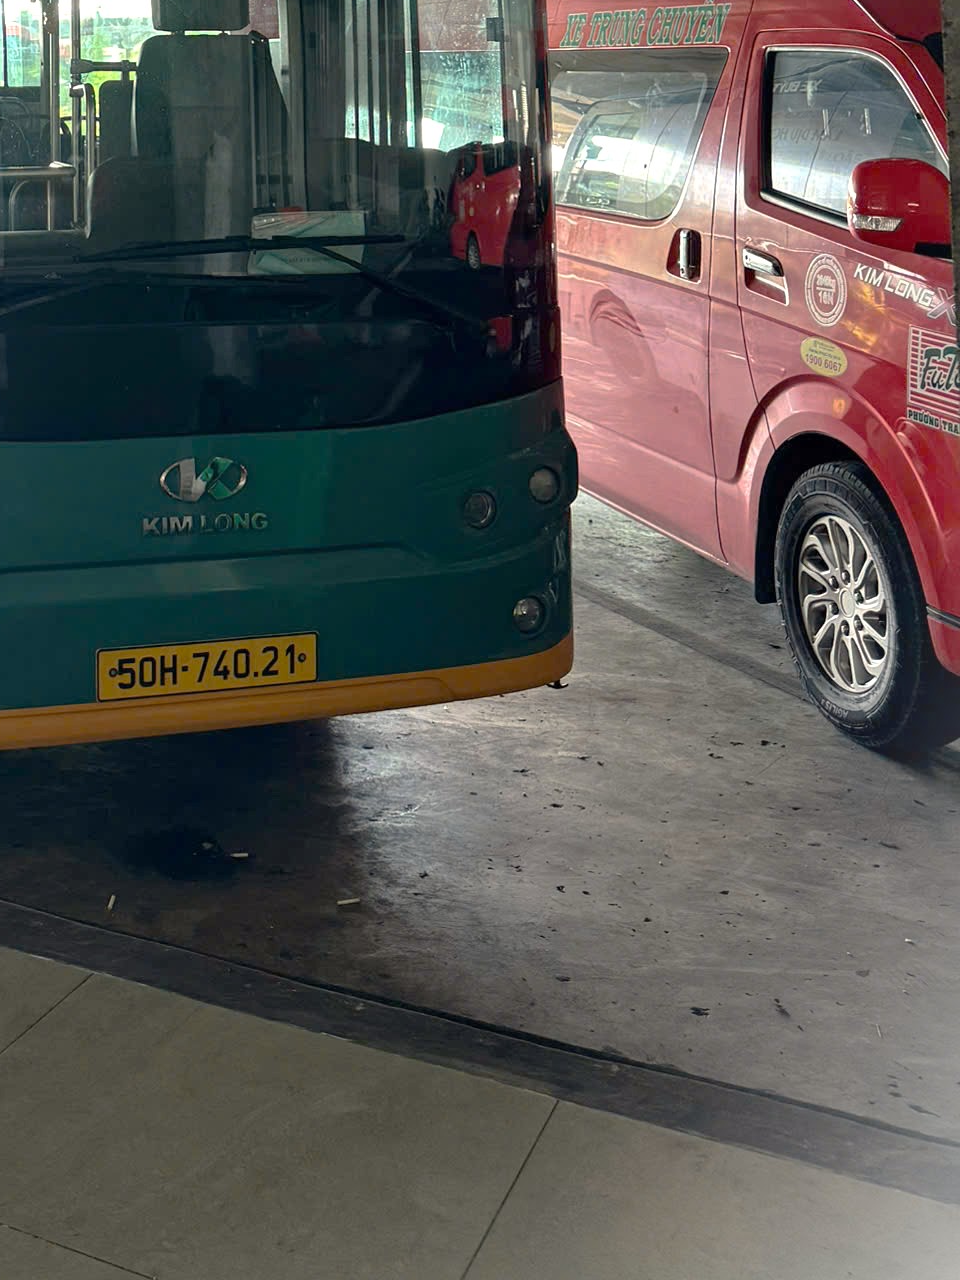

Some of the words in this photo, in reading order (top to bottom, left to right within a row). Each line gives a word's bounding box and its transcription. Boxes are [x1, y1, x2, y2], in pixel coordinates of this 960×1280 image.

[559, 12, 589, 48] XE
[587, 7, 648, 48] TRUNG
[854, 263, 884, 288] KIM
[884, 276, 936, 308] LONG
[805, 353, 824, 368] 1900
[824, 357, 843, 372] 6067
[142, 516, 193, 537] KIM
[200, 512, 269, 532] LONG
[117, 643, 296, 690] 50H-740.21
